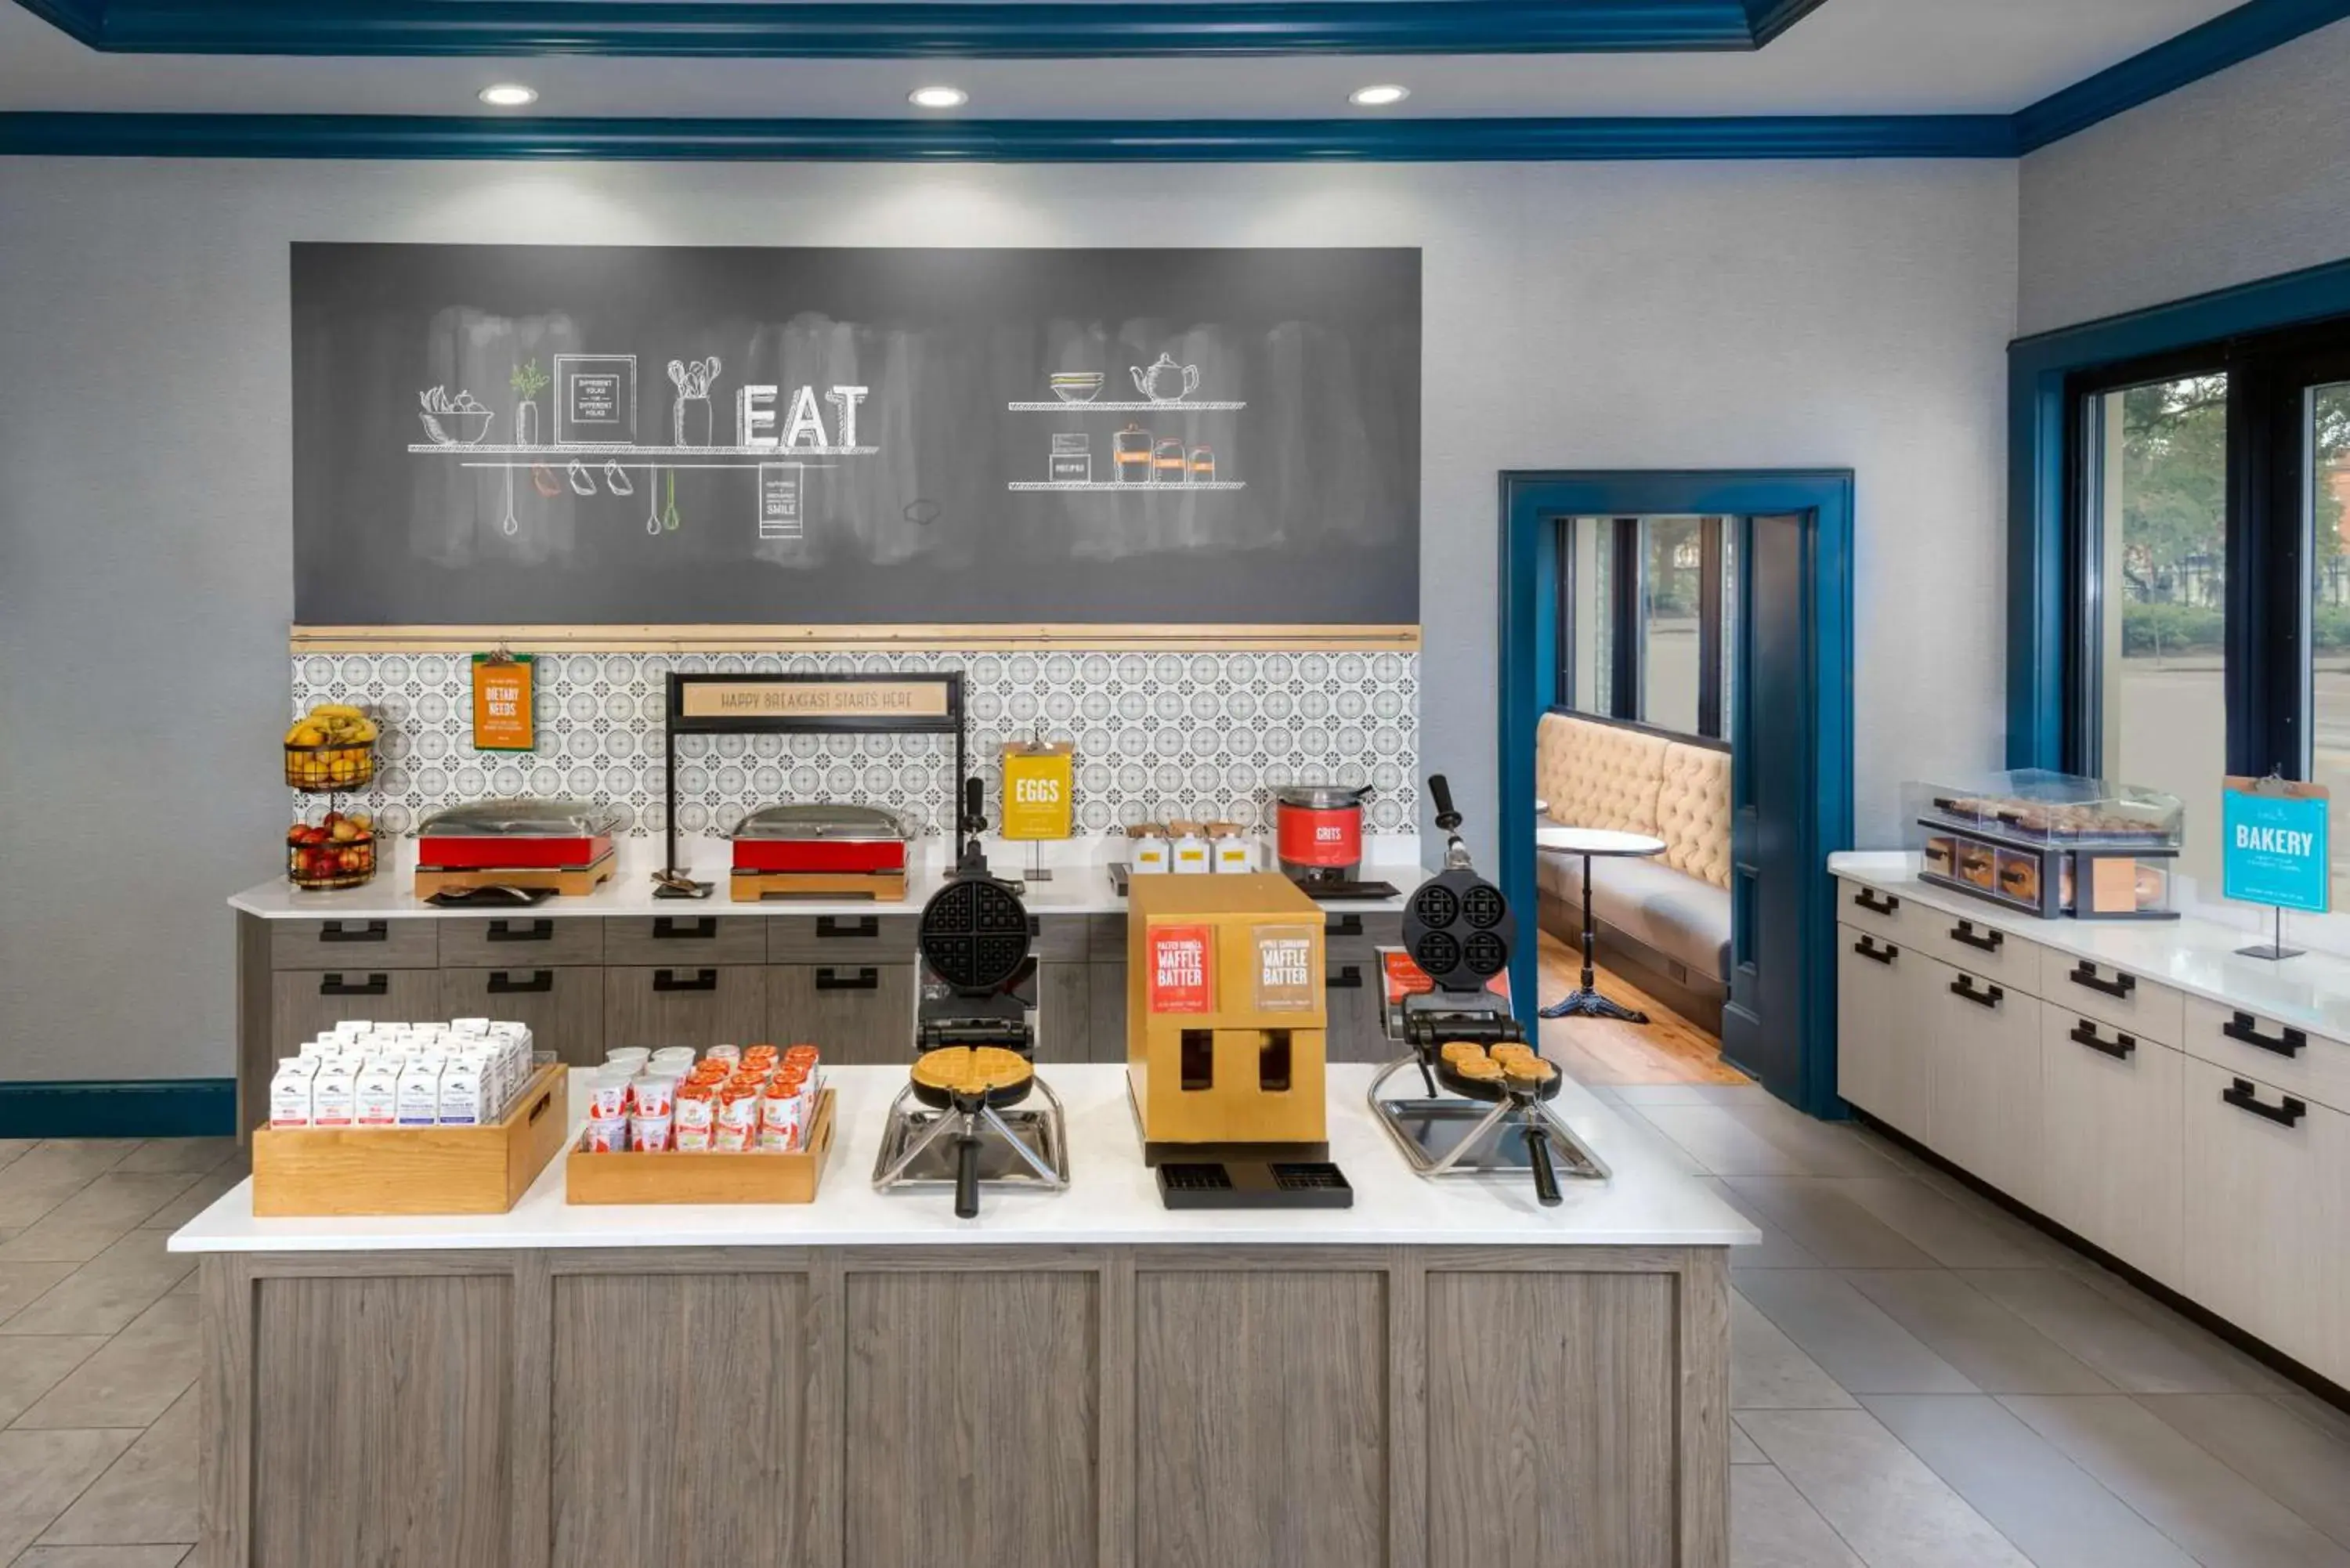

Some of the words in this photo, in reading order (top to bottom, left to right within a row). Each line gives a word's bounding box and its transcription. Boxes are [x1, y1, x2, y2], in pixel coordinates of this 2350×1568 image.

[736, 385, 869, 451] EAT
[721, 692, 760, 709] HAPPY
[763, 691, 830, 709] BREAKFAST
[833, 691, 878, 708] STARTS
[882, 691, 913, 708] HERE
[1016, 778, 1060, 803] EGGS
[2236, 823, 2313, 858] BAKERY
[1158, 950, 1203, 968] WAFFLE
[1263, 948, 1308, 967] WAFFLE
[1158, 968, 1203, 987] BATTER
[1263, 967, 1308, 986] BATTER
